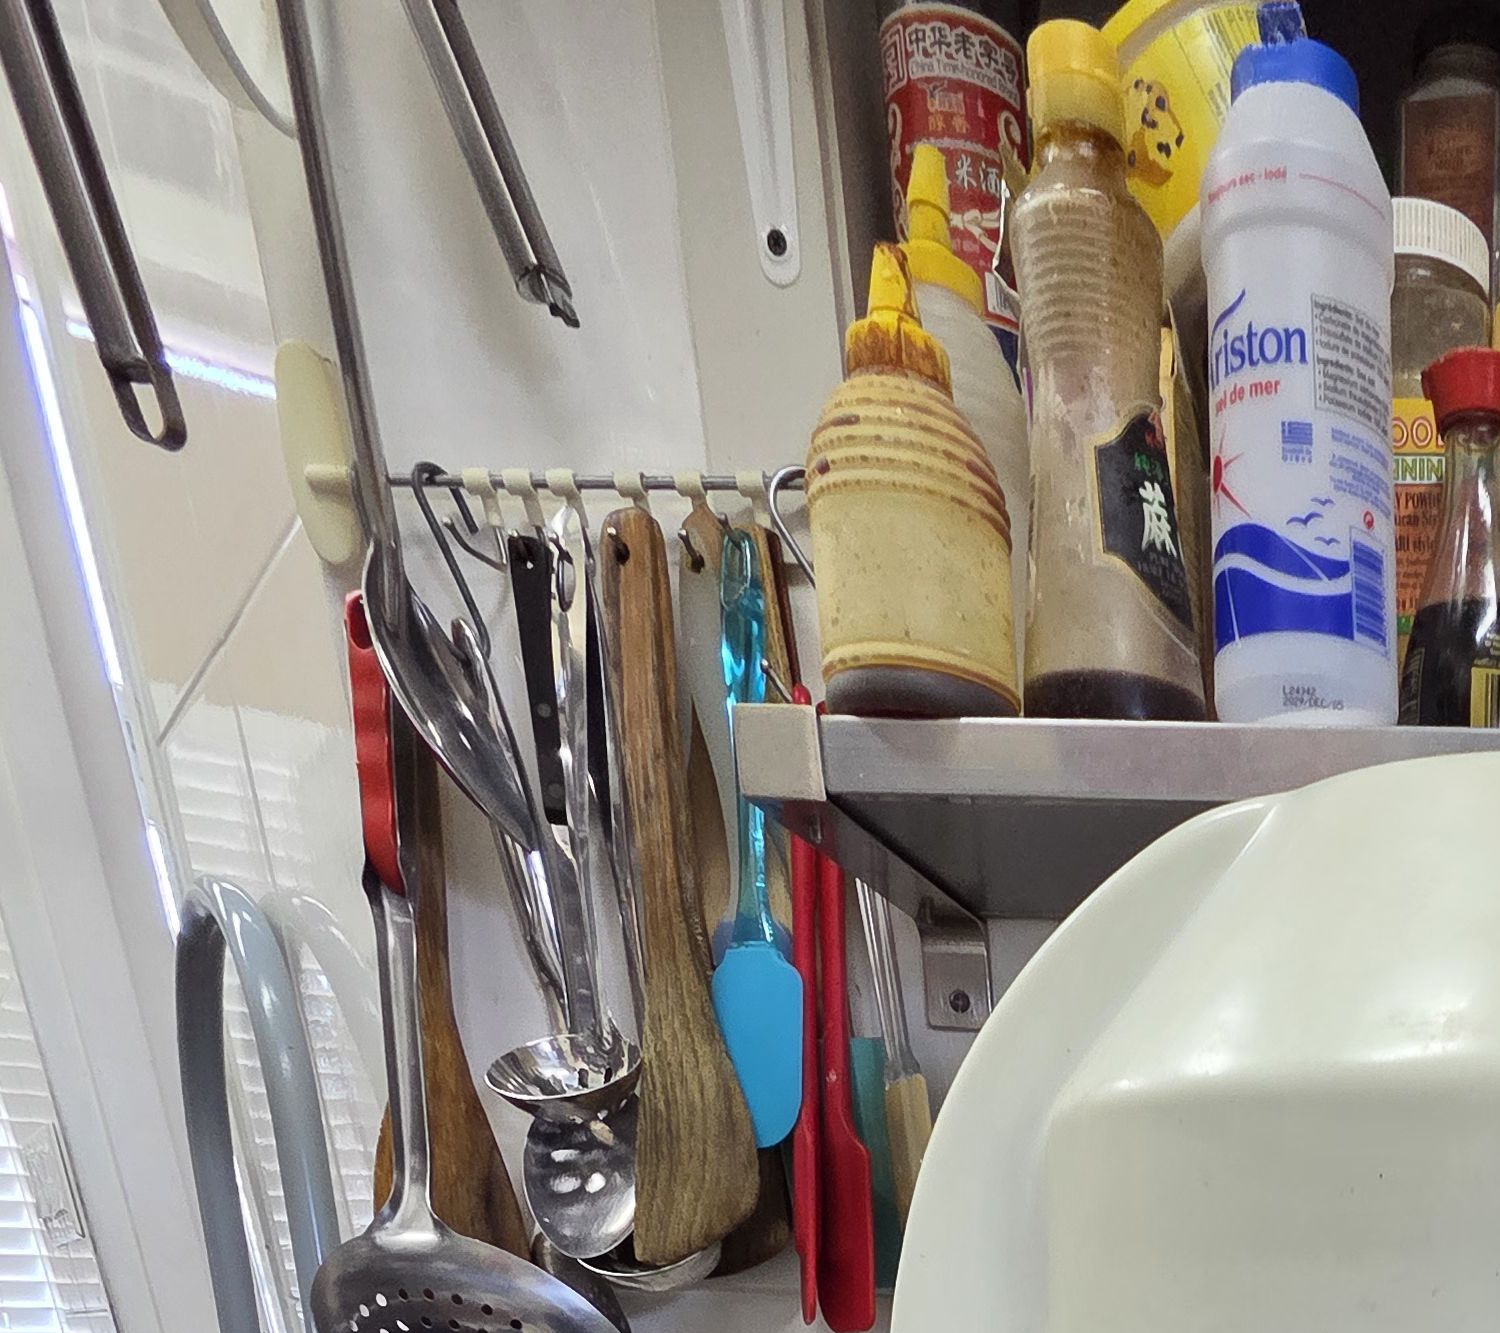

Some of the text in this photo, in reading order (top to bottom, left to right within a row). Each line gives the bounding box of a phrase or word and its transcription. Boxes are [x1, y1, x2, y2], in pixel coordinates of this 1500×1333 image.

[906, 24, 1017, 80] 中华老字号
[955, 153, 1002, 198] 米酒
[1229, 383, 1245, 405] de
[1249, 380, 1280, 398] mer
